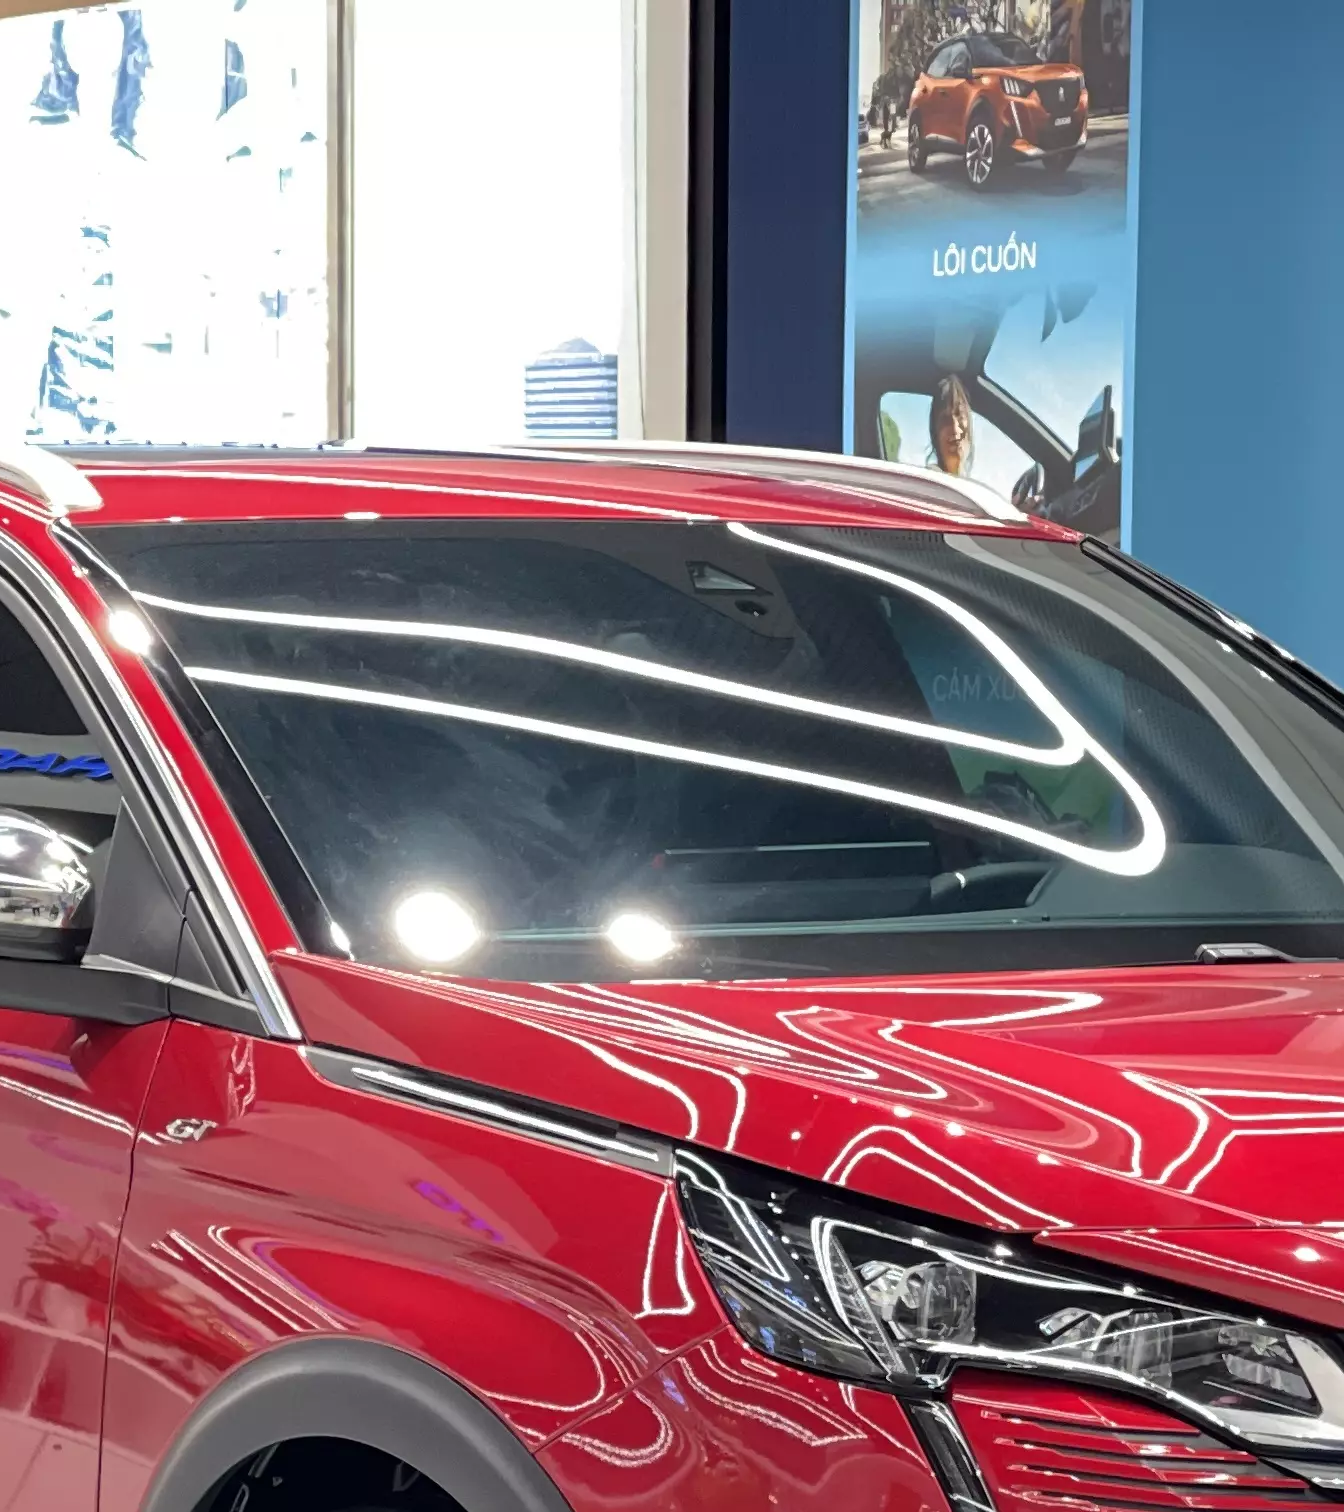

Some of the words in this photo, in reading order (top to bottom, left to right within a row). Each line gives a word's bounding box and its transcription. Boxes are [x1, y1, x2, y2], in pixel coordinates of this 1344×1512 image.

[933, 242, 966, 276] LÔI
[971, 231, 1037, 274] CUỐN
[165, 1118, 219, 1141] GT
